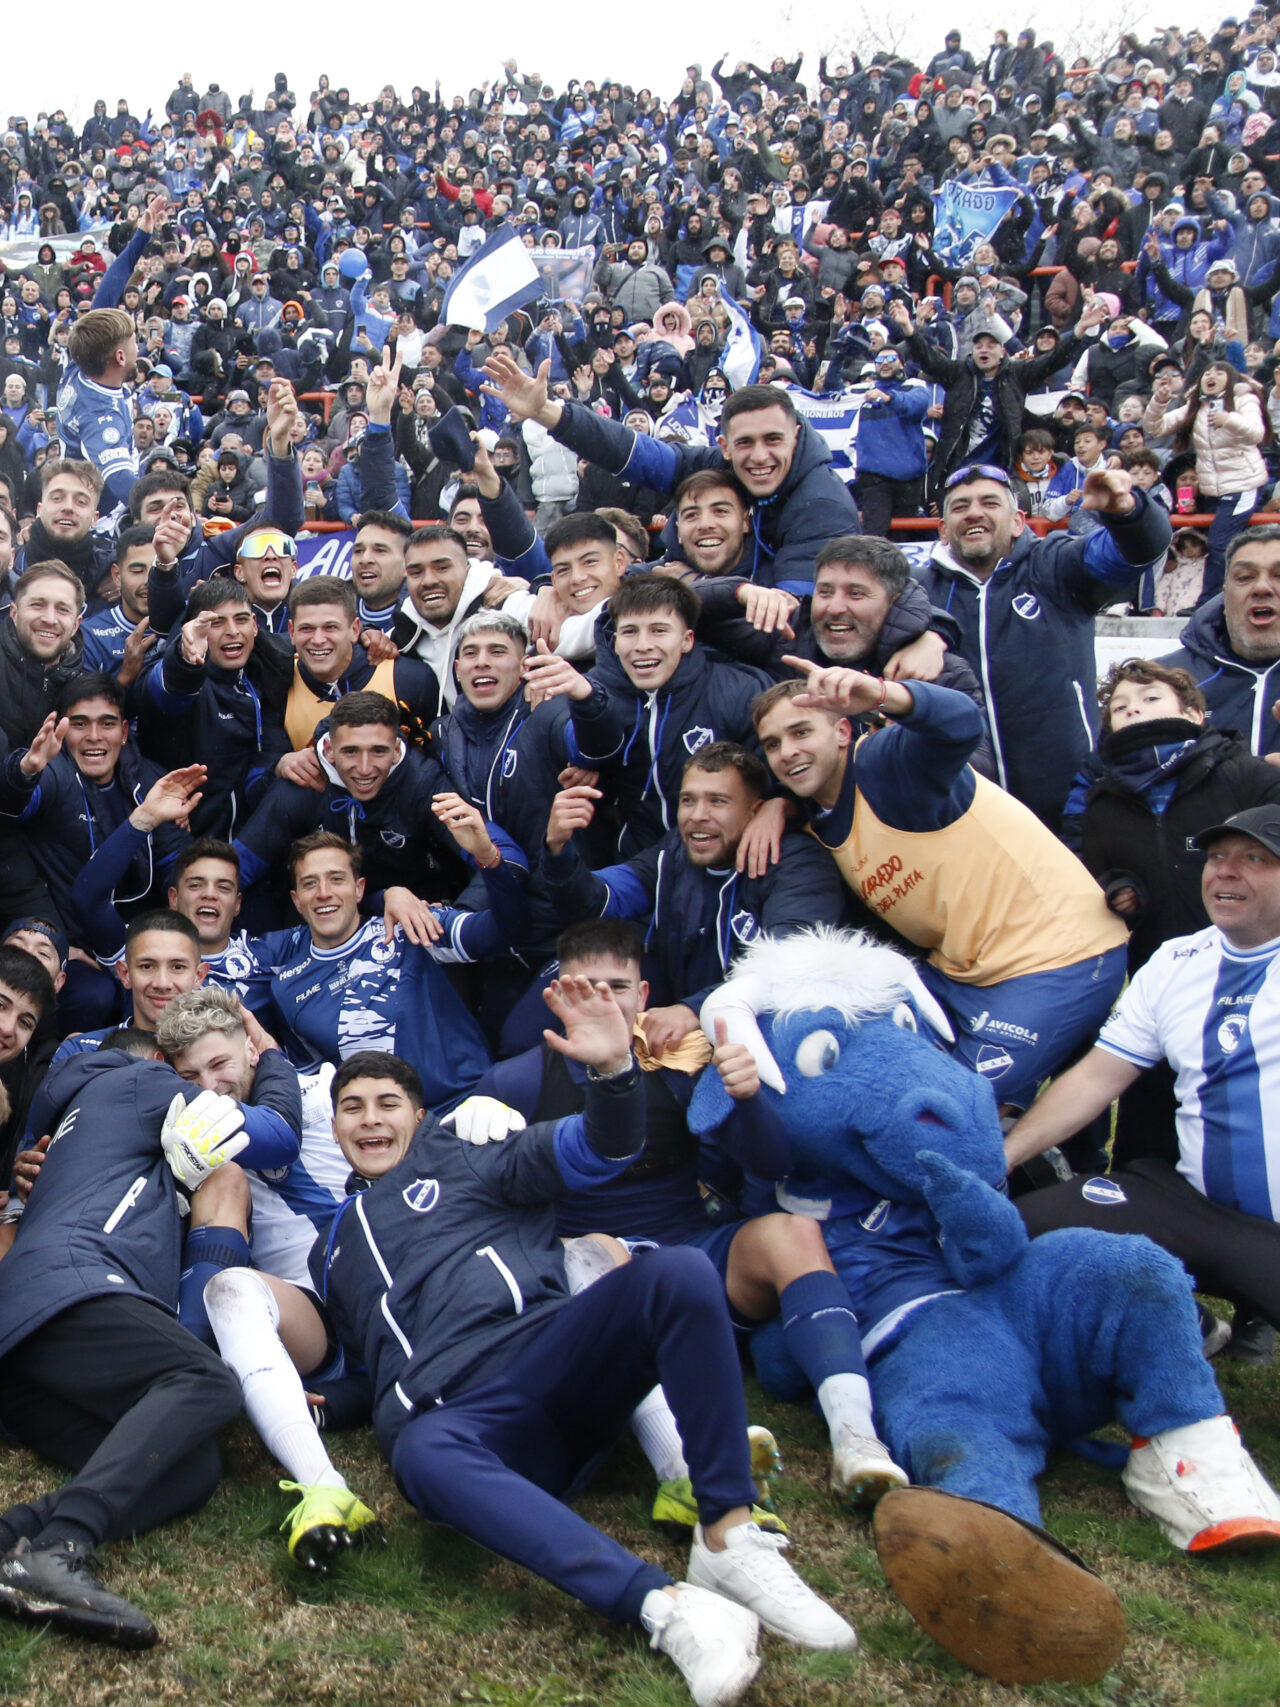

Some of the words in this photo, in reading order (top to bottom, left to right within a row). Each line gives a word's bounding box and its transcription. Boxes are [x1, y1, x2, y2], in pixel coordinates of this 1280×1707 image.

[891, 867, 925, 899] PLATA
[279, 961, 308, 982] Hergo
[295, 983, 321, 1004] FIUME
[1217, 994, 1255, 1006] FIUME
[986, 1019, 1038, 1042] AVICOLA
[180, 1142, 206, 1173] PROSTAR
